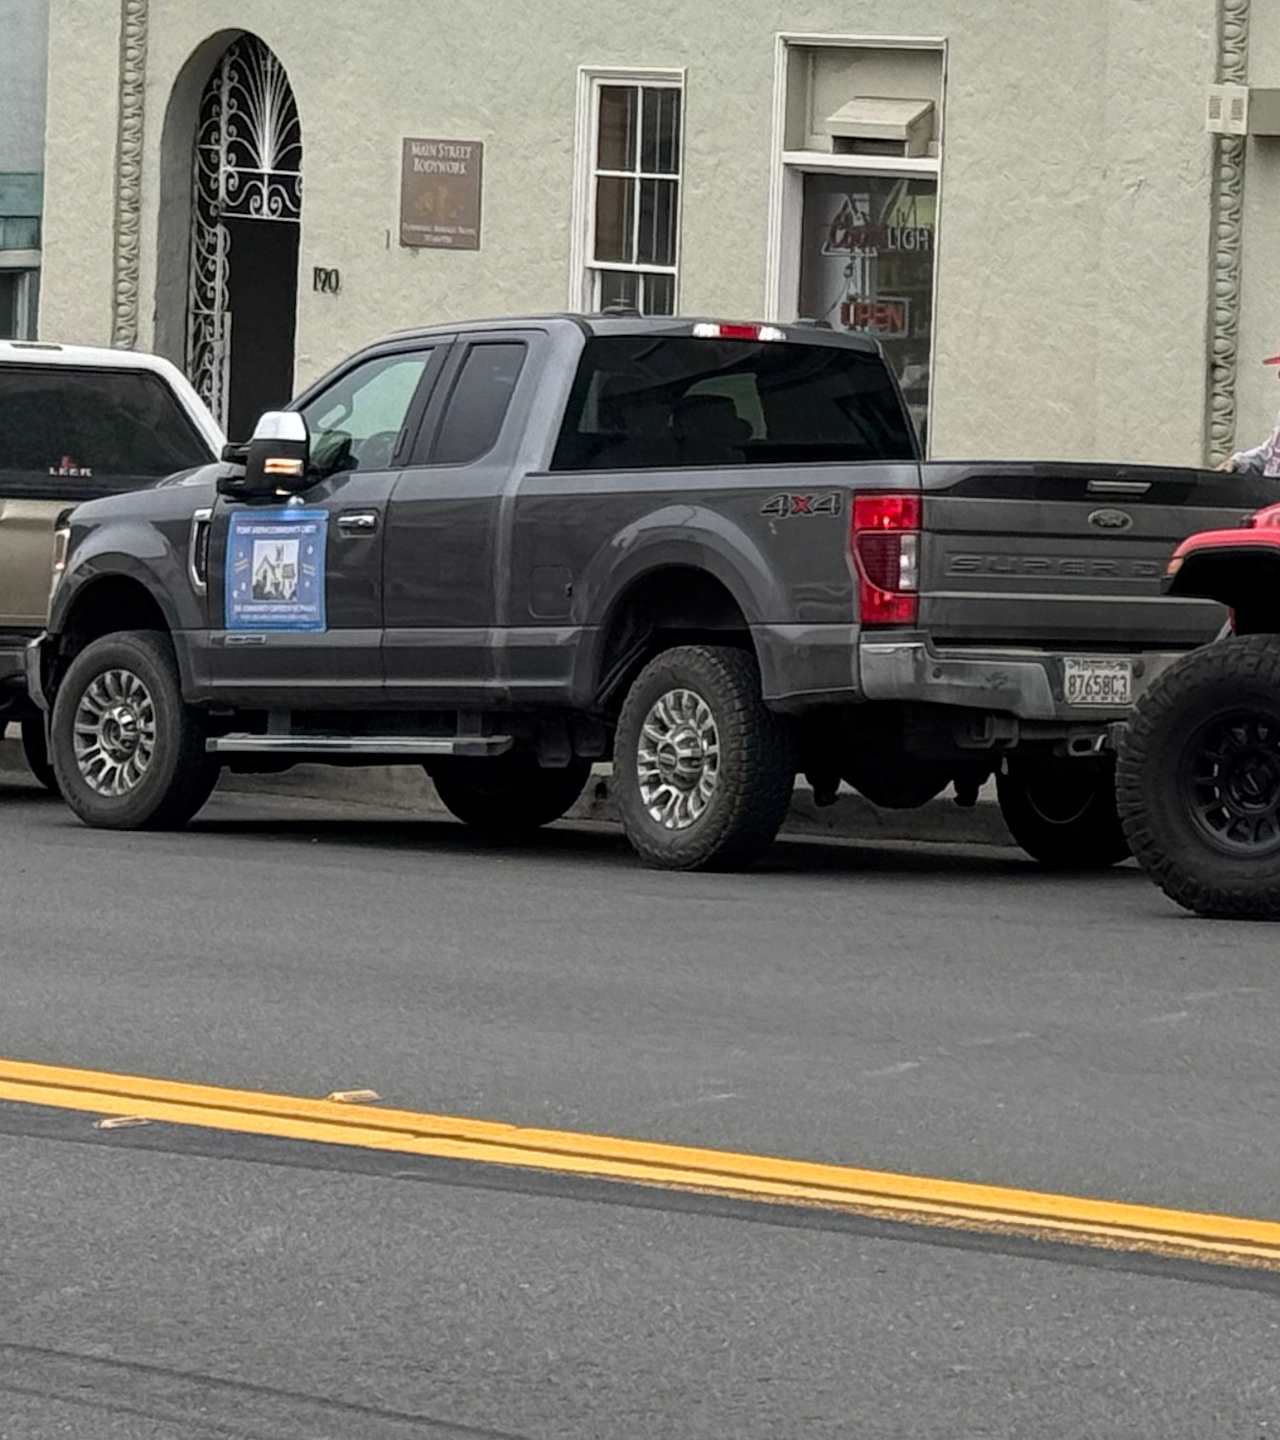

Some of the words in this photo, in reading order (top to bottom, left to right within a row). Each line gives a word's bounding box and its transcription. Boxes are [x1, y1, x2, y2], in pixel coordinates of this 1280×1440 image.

[887, 225, 930, 252] LIGH
[313, 266, 340, 294] 190
[840, 301, 905, 335] OPEN
[950, 555, 1120, 578] SUPER
